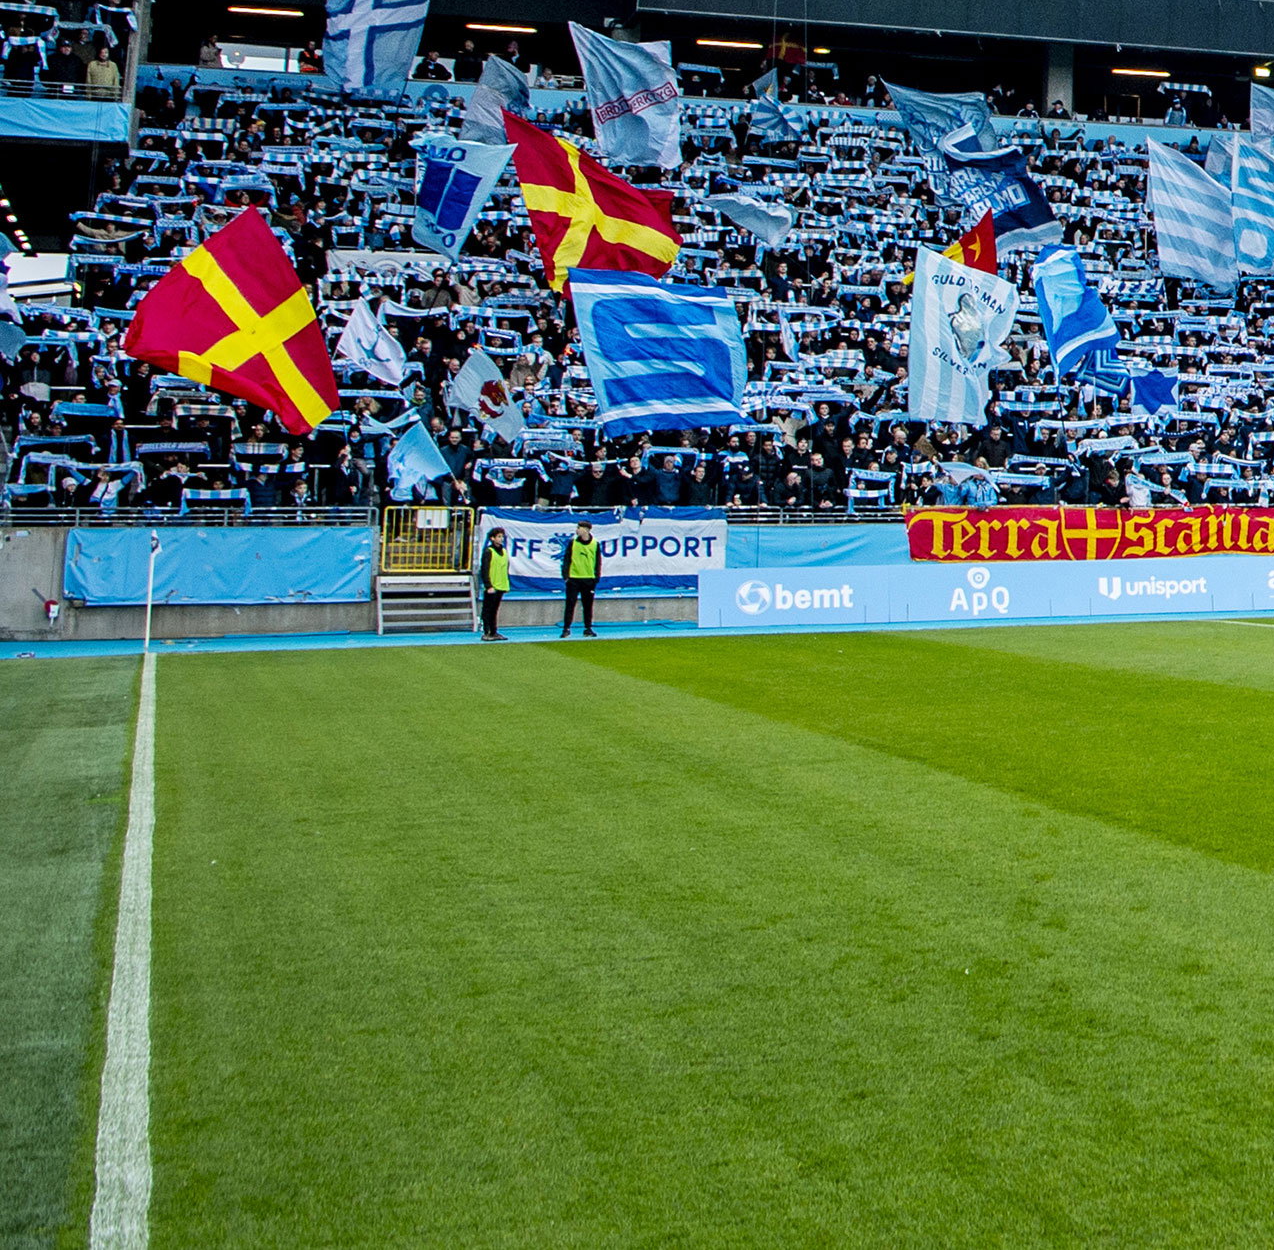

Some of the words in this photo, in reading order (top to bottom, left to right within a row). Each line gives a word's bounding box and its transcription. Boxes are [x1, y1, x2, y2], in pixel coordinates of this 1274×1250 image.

[601, 536, 717, 558] UPPORT
[908, 510, 1062, 559] Terra
[775, 584, 854, 610] bemt
[1126, 576, 1207, 599] unisport
[950, 587, 1010, 616] ApQ
